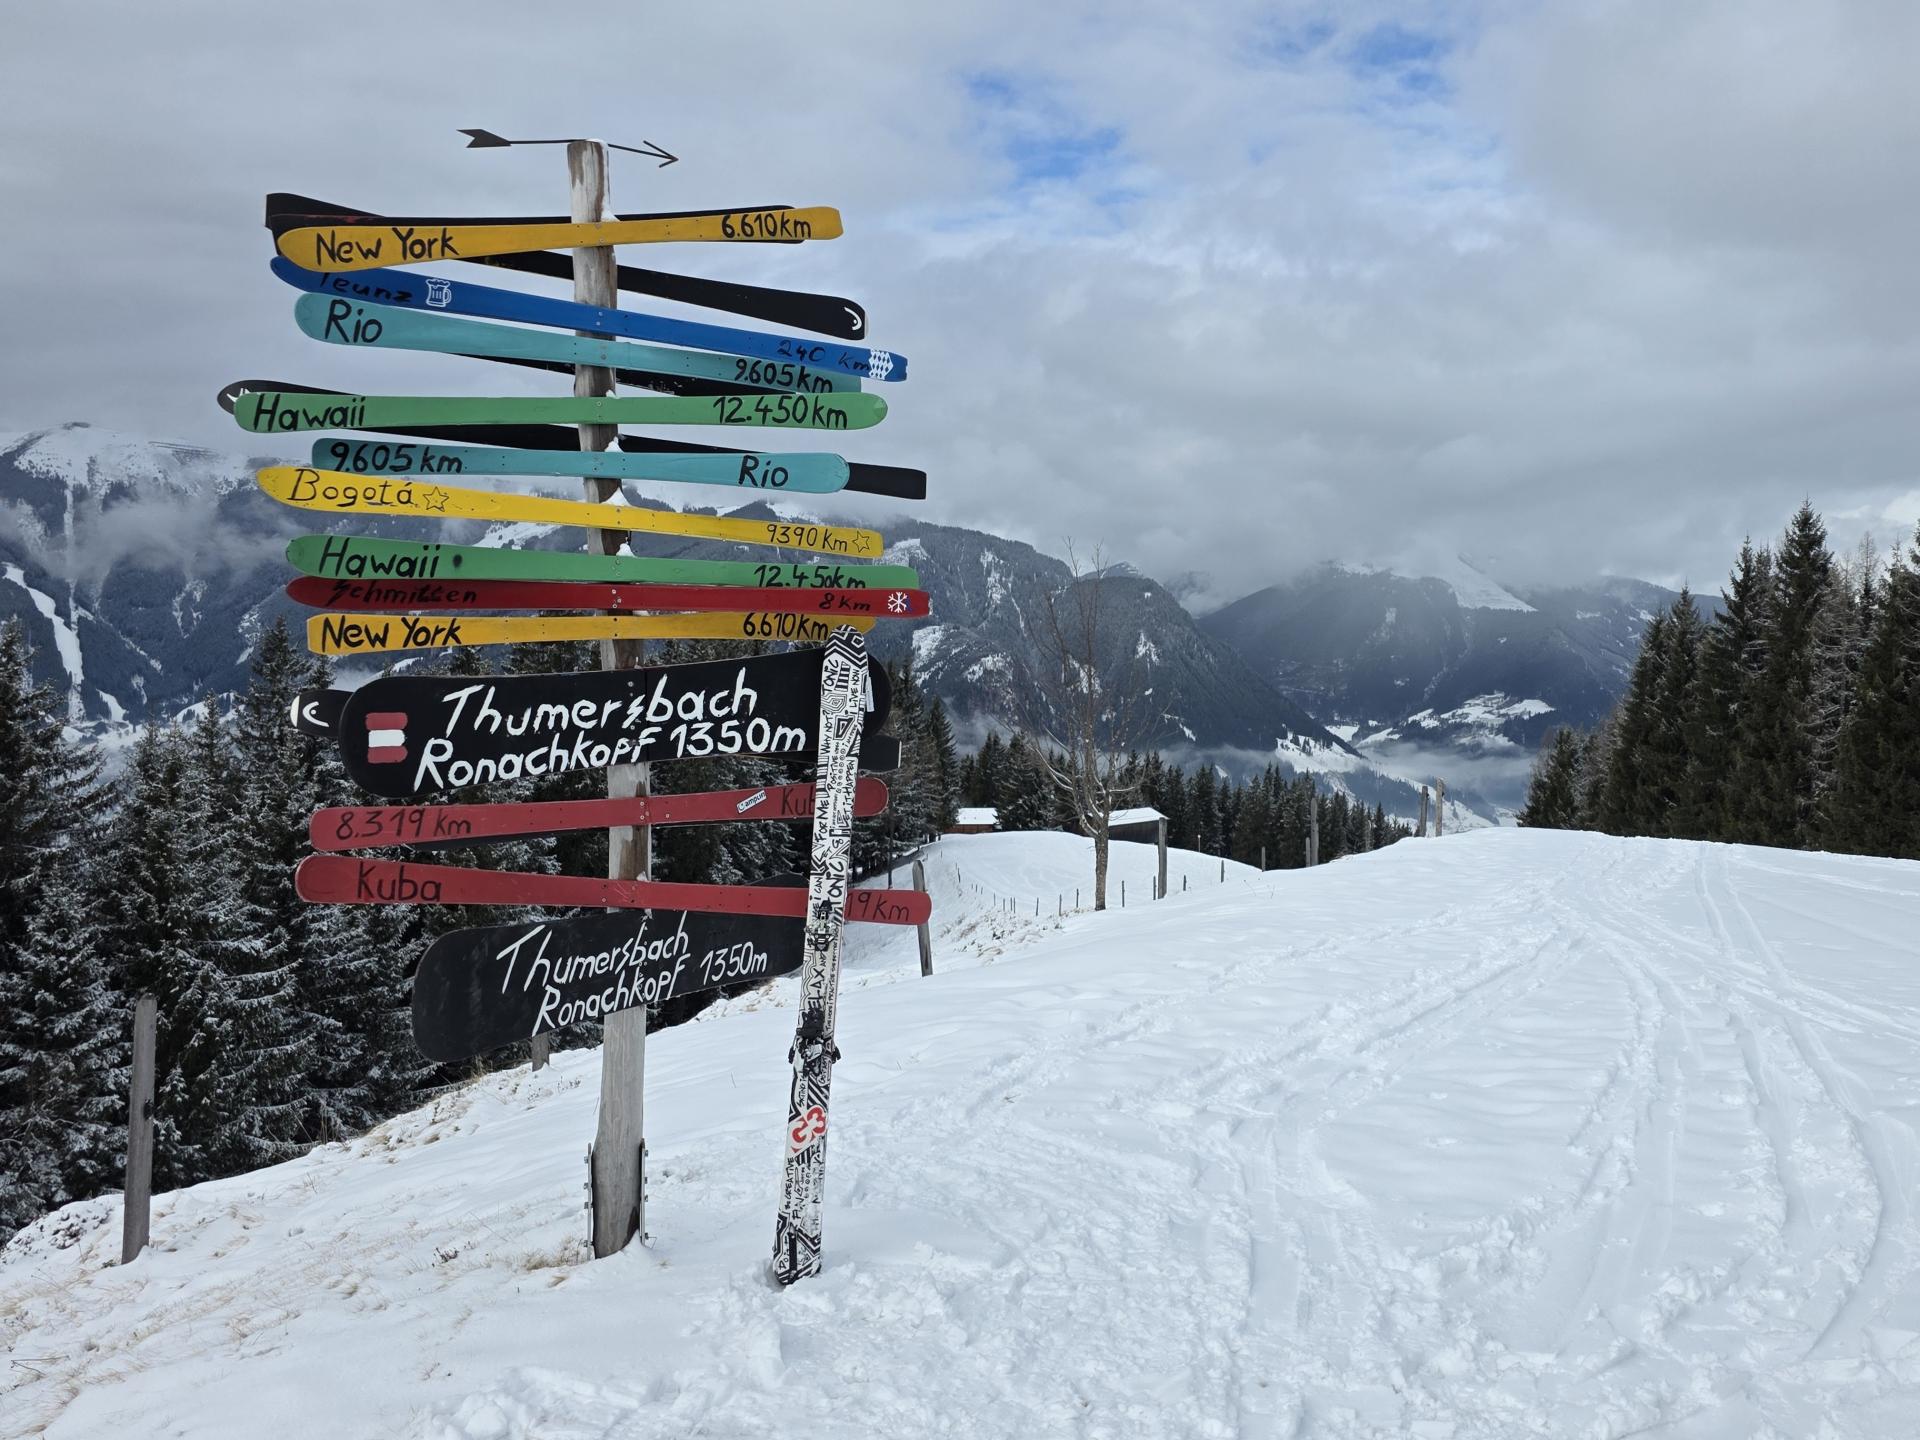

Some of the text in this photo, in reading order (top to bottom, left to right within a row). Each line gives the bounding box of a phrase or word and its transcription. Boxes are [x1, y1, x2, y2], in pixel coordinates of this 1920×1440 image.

[316, 227, 459, 266] New York
[325, 299, 383, 344] Rio
[253, 393, 367, 431] Hawaii
[287, 468, 414, 508] Bogotá
[738, 454, 789, 488] Rio
[318, 535, 440, 578] Hawaii
[819, 592, 835, 610] 8
[322, 615, 462, 653] New York
[442, 666, 758, 738] Thumersbach
[413, 727, 662, 793] Ronachkopf
[670, 717, 807, 758] 1350m
[820, 734, 832, 755] WHY
[782, 785, 816, 816] Kub
[814, 799, 830, 843] FOR ME
[356, 861, 443, 903] Kuba
[496, 910, 689, 993] Thumersbach
[531, 941, 768, 1037] Ronachkopf 1350m
